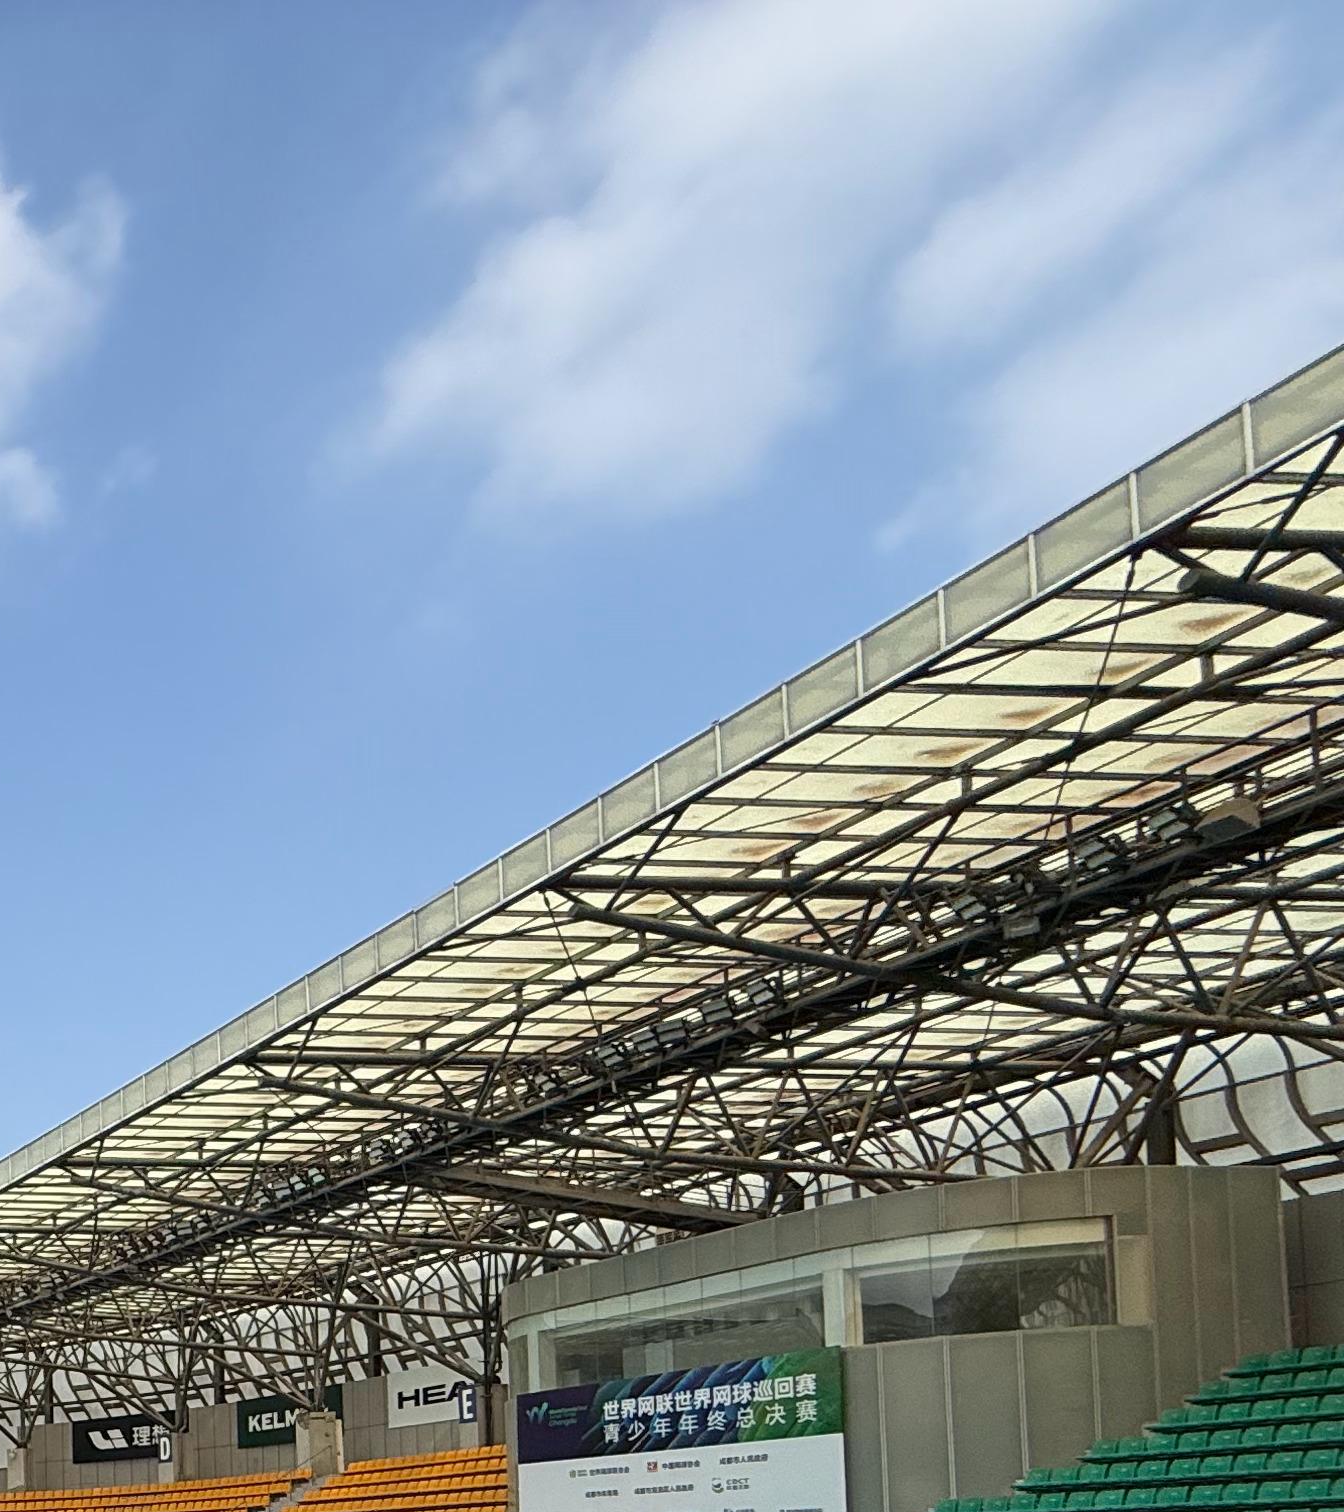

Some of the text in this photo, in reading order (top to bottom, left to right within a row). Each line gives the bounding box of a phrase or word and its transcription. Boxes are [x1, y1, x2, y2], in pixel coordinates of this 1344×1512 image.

[397, 1380, 462, 1409] HEA
[462, 1388, 473, 1419] E
[602, 1373, 817, 1420] 世界网联世界网球巡回赛
[248, 1408, 300, 1433] KELM
[602, 1400, 818, 1444] 青少年年终总决赛
[159, 1439, 170, 1460] D
